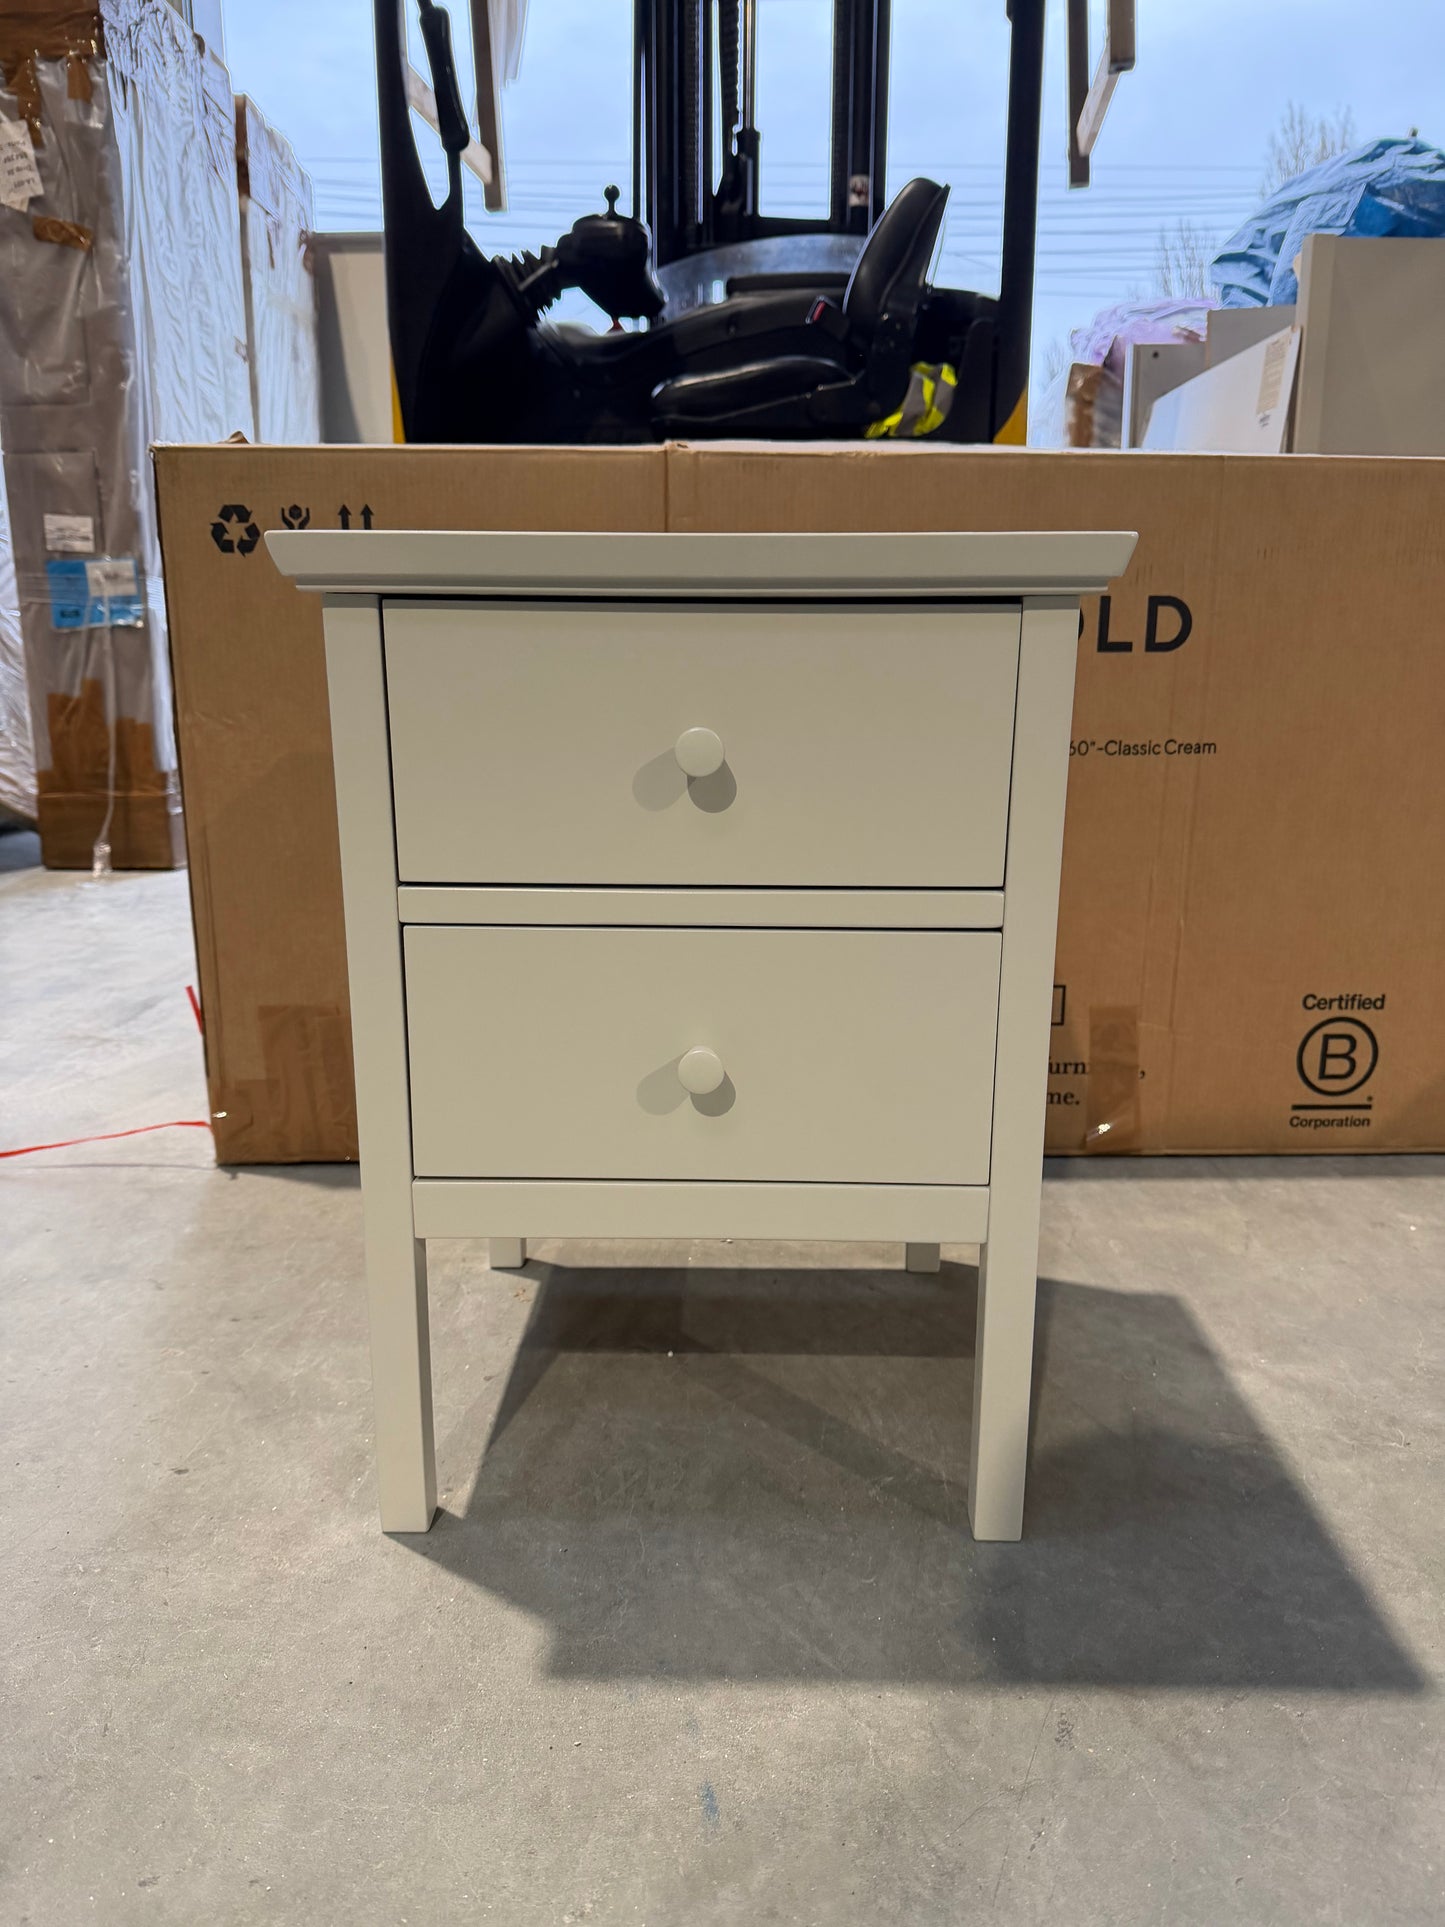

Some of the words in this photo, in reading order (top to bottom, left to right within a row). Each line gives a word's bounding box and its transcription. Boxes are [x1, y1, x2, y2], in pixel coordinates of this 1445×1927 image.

[1078, 595, 1193, 653] LD
[1164, 739, 1217, 756] Cream
[1302, 993, 1386, 1011] Certified
[1318, 1033, 1357, 1080] B
[1289, 1115, 1371, 1130] Corporation
